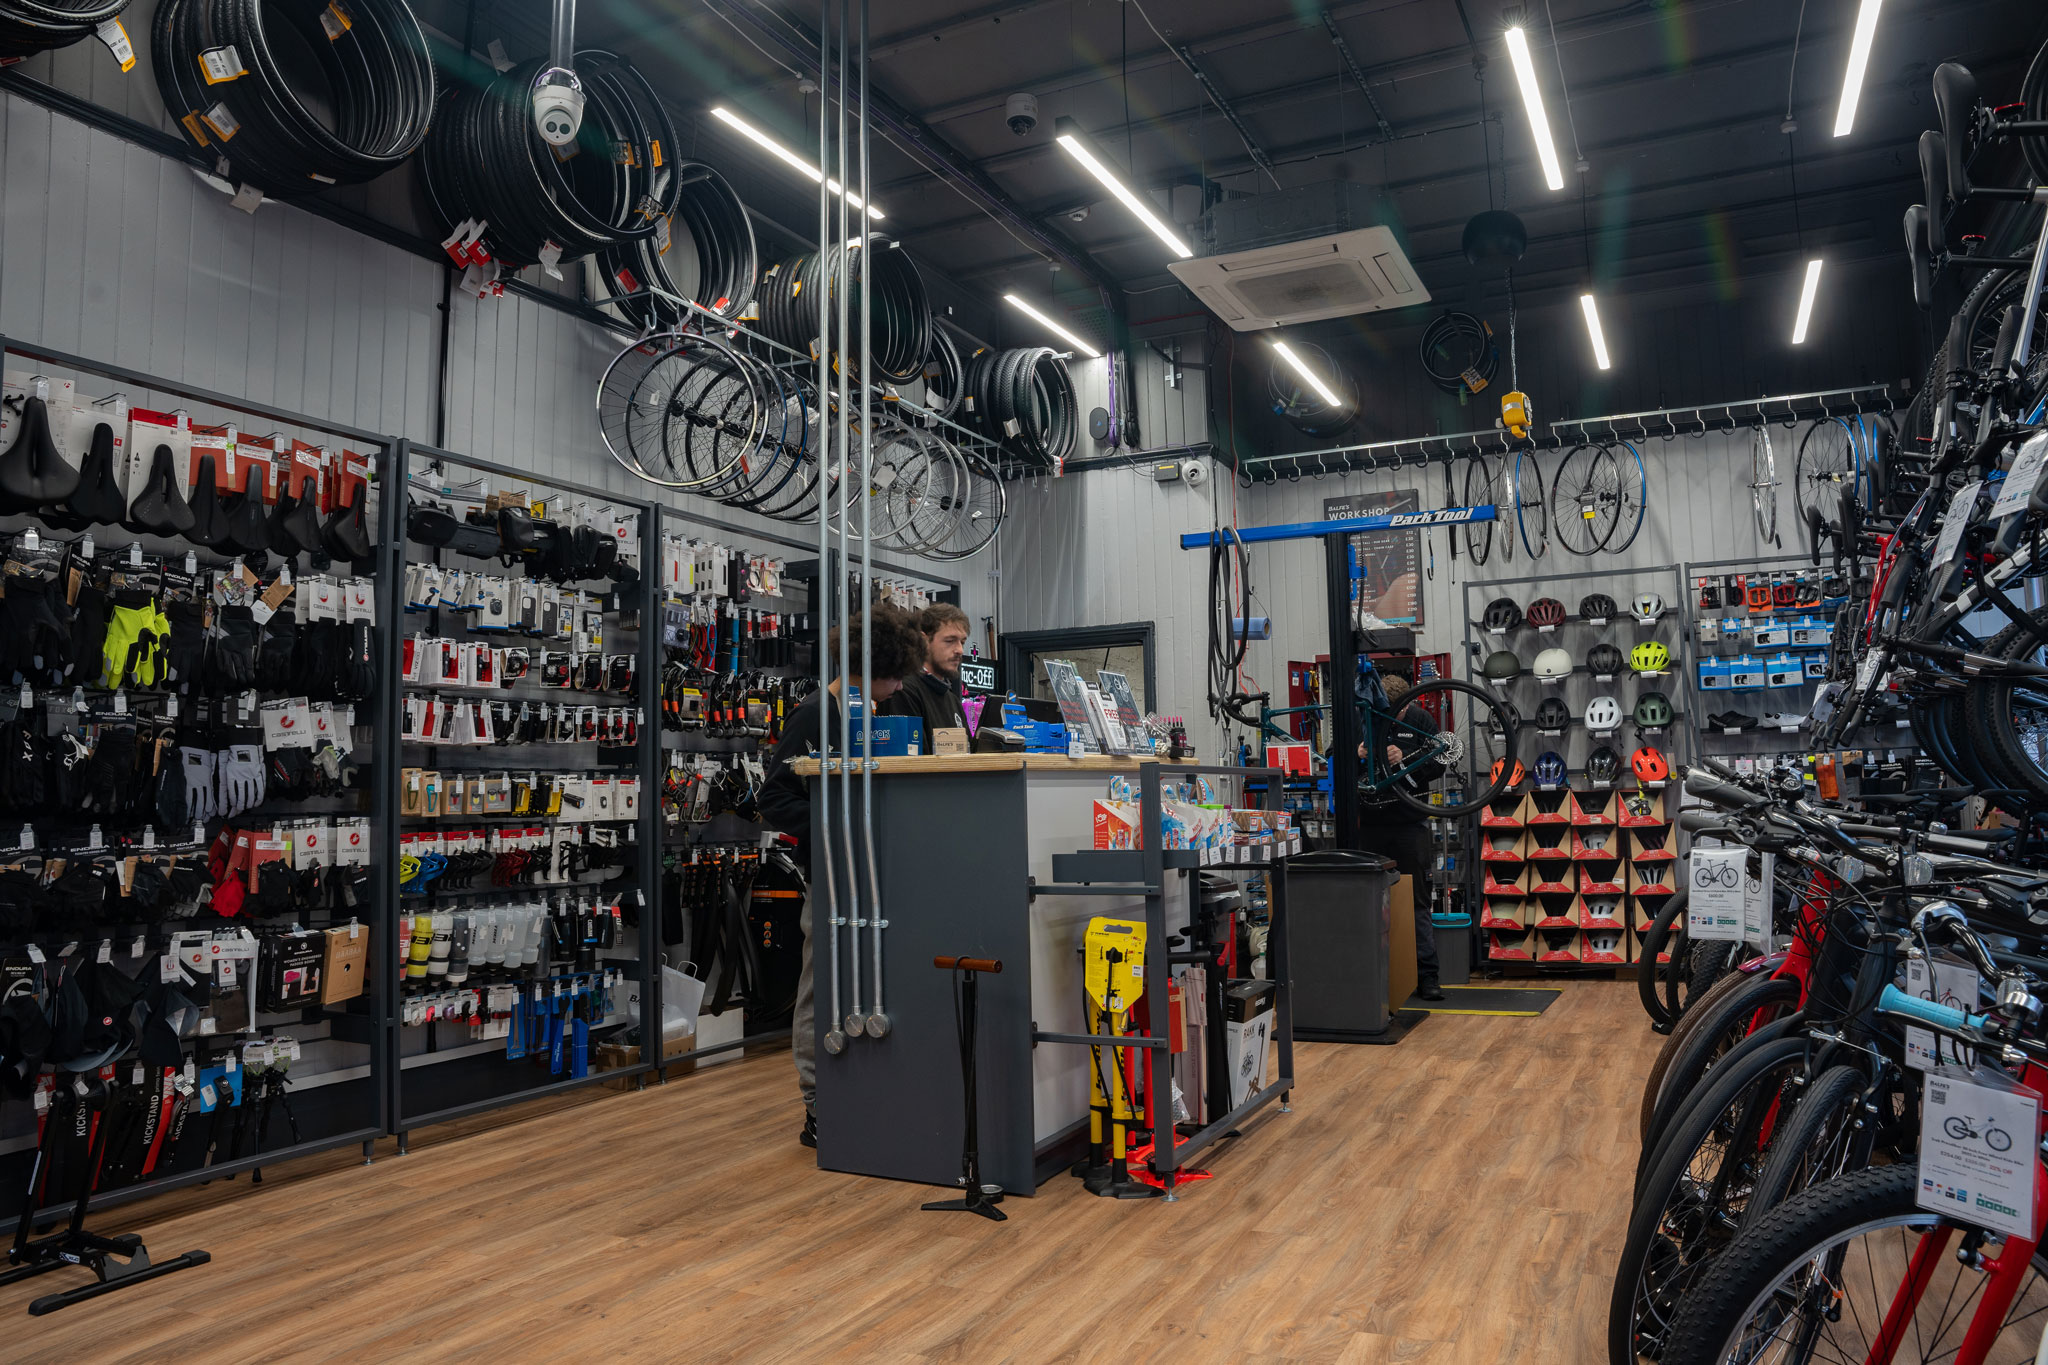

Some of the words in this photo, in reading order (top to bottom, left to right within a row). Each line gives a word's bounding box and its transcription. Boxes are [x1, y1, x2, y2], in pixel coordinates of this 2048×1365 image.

[1328, 504, 1350, 512] BALFE'S
[1328, 507, 1390, 520] WORKSHOP
[165, 572, 192, 583] ENDURA
[272, 729, 306, 738] CASTELLI
[299, 849, 325, 857] CASTELLI
[143, 1095, 160, 1145] KICKSTAND
